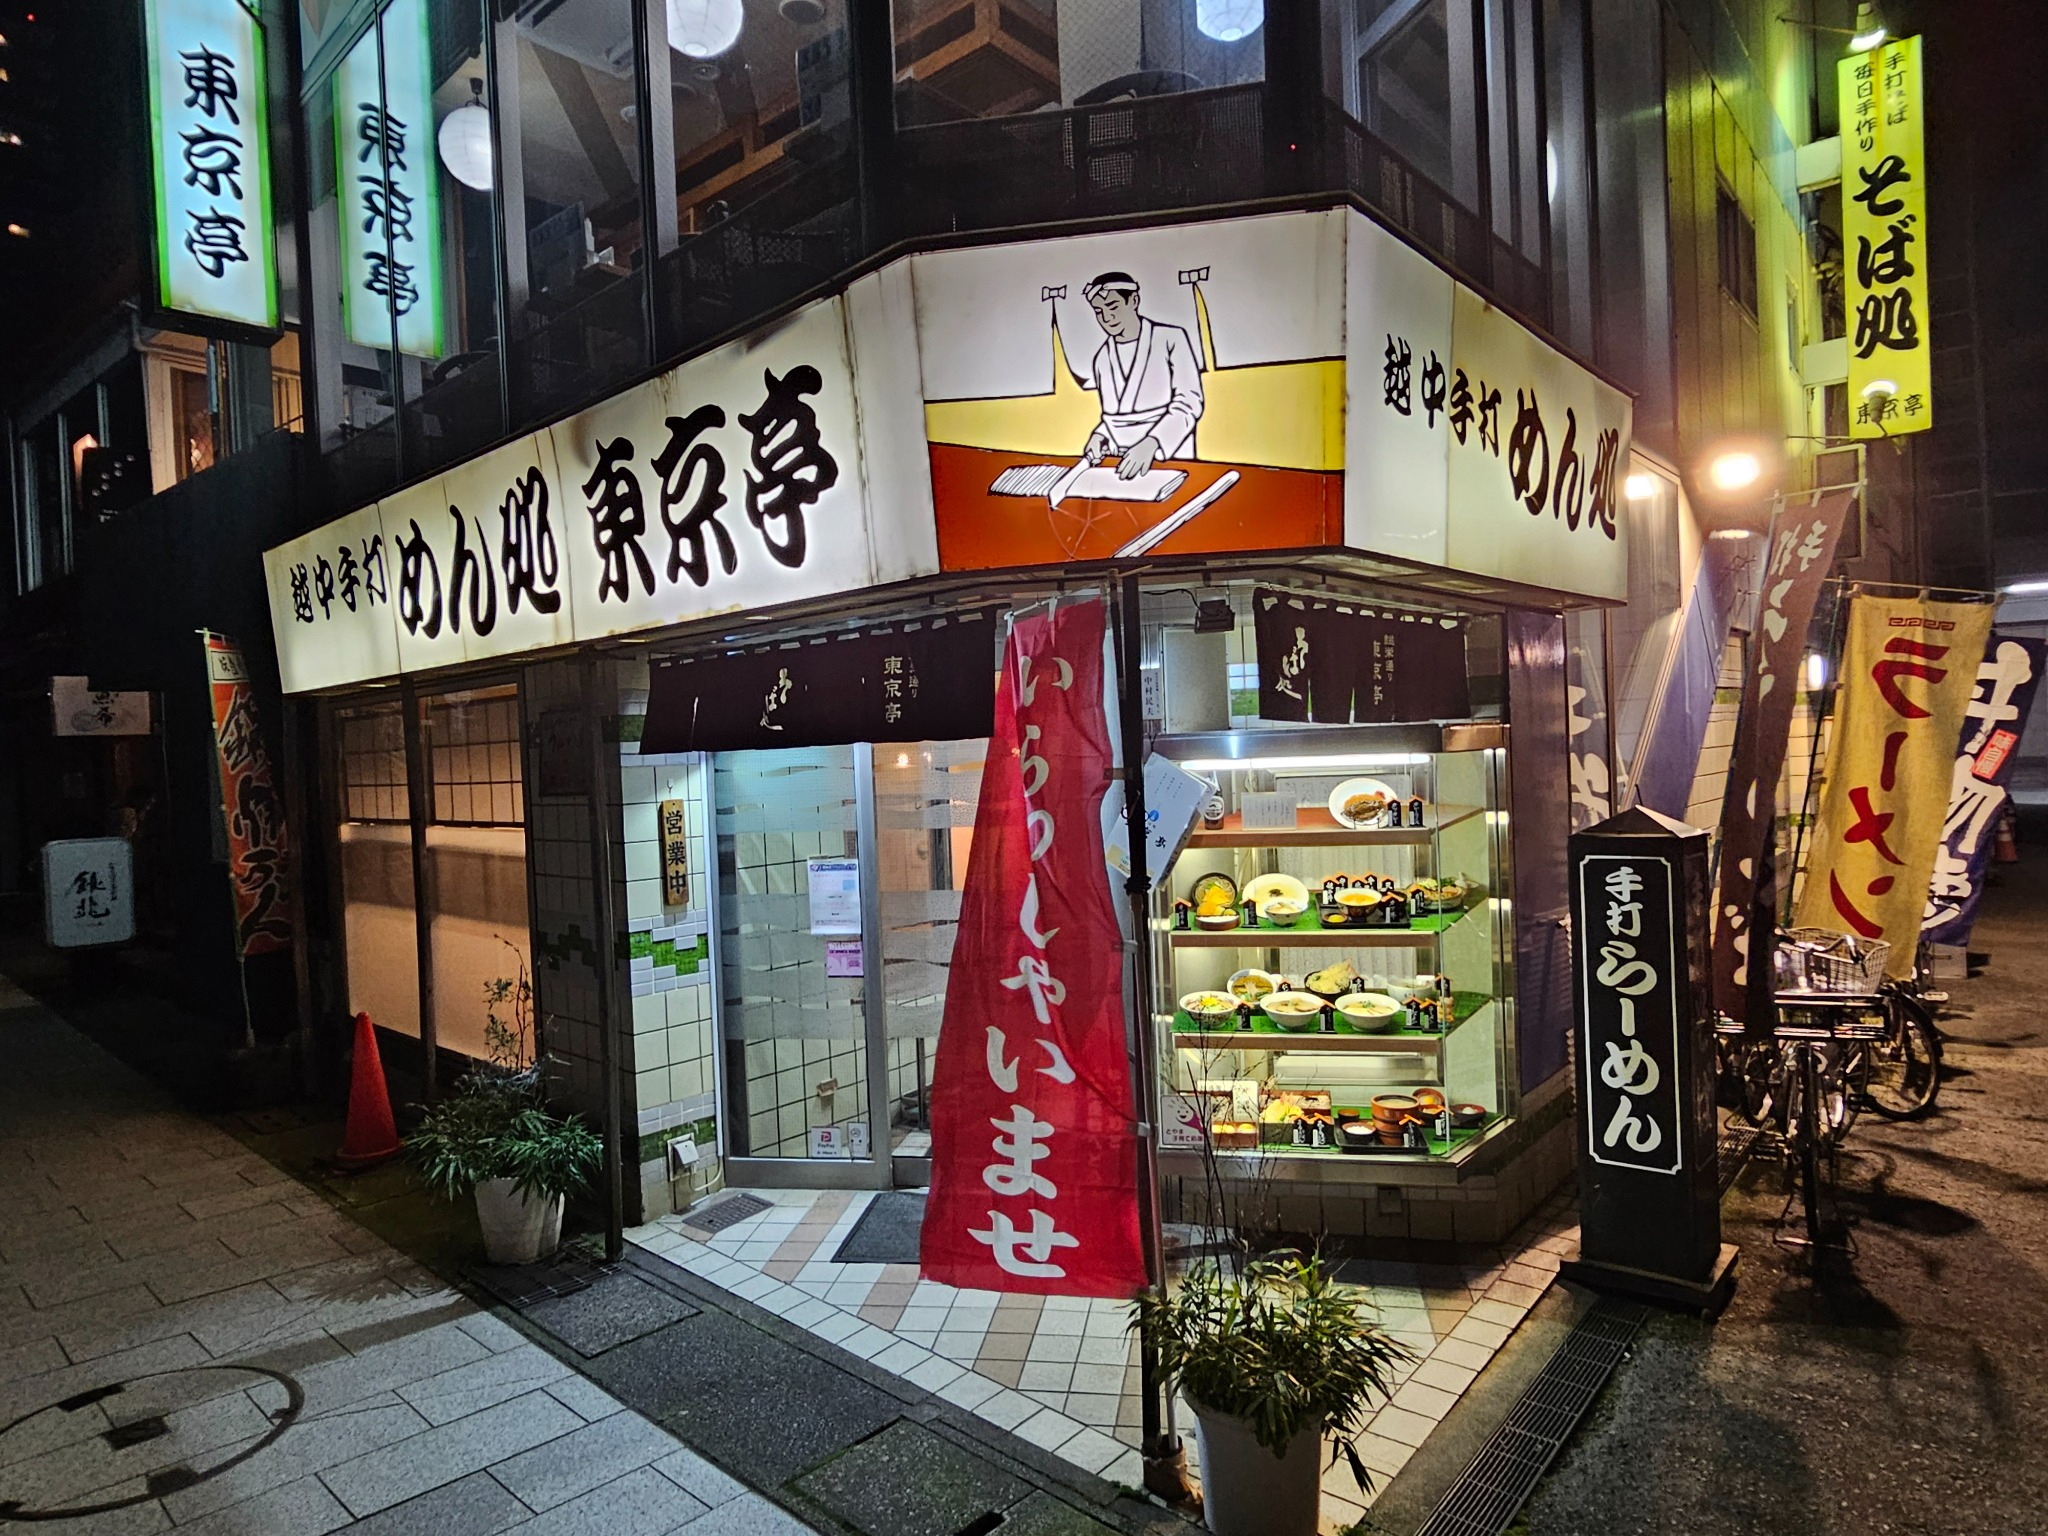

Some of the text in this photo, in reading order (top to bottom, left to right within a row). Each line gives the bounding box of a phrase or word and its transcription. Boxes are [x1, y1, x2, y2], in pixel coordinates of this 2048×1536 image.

[178, 42, 249, 279] 東京亭
[1854, 61, 1877, 152] 毎日手作り
[1853, 155, 1919, 359] そば処
[581, 365, 838, 602] 東京亭
[883, 655, 903, 723] 東京亭
[1275, 626, 1309, 700] そば処
[1372, 640, 1383, 706] 東京亭
[665, 810, 687, 895] 営業中
[1830, 636, 1950, 939] ラーメン
[1597, 866, 1661, 1153] 手打らーめん
